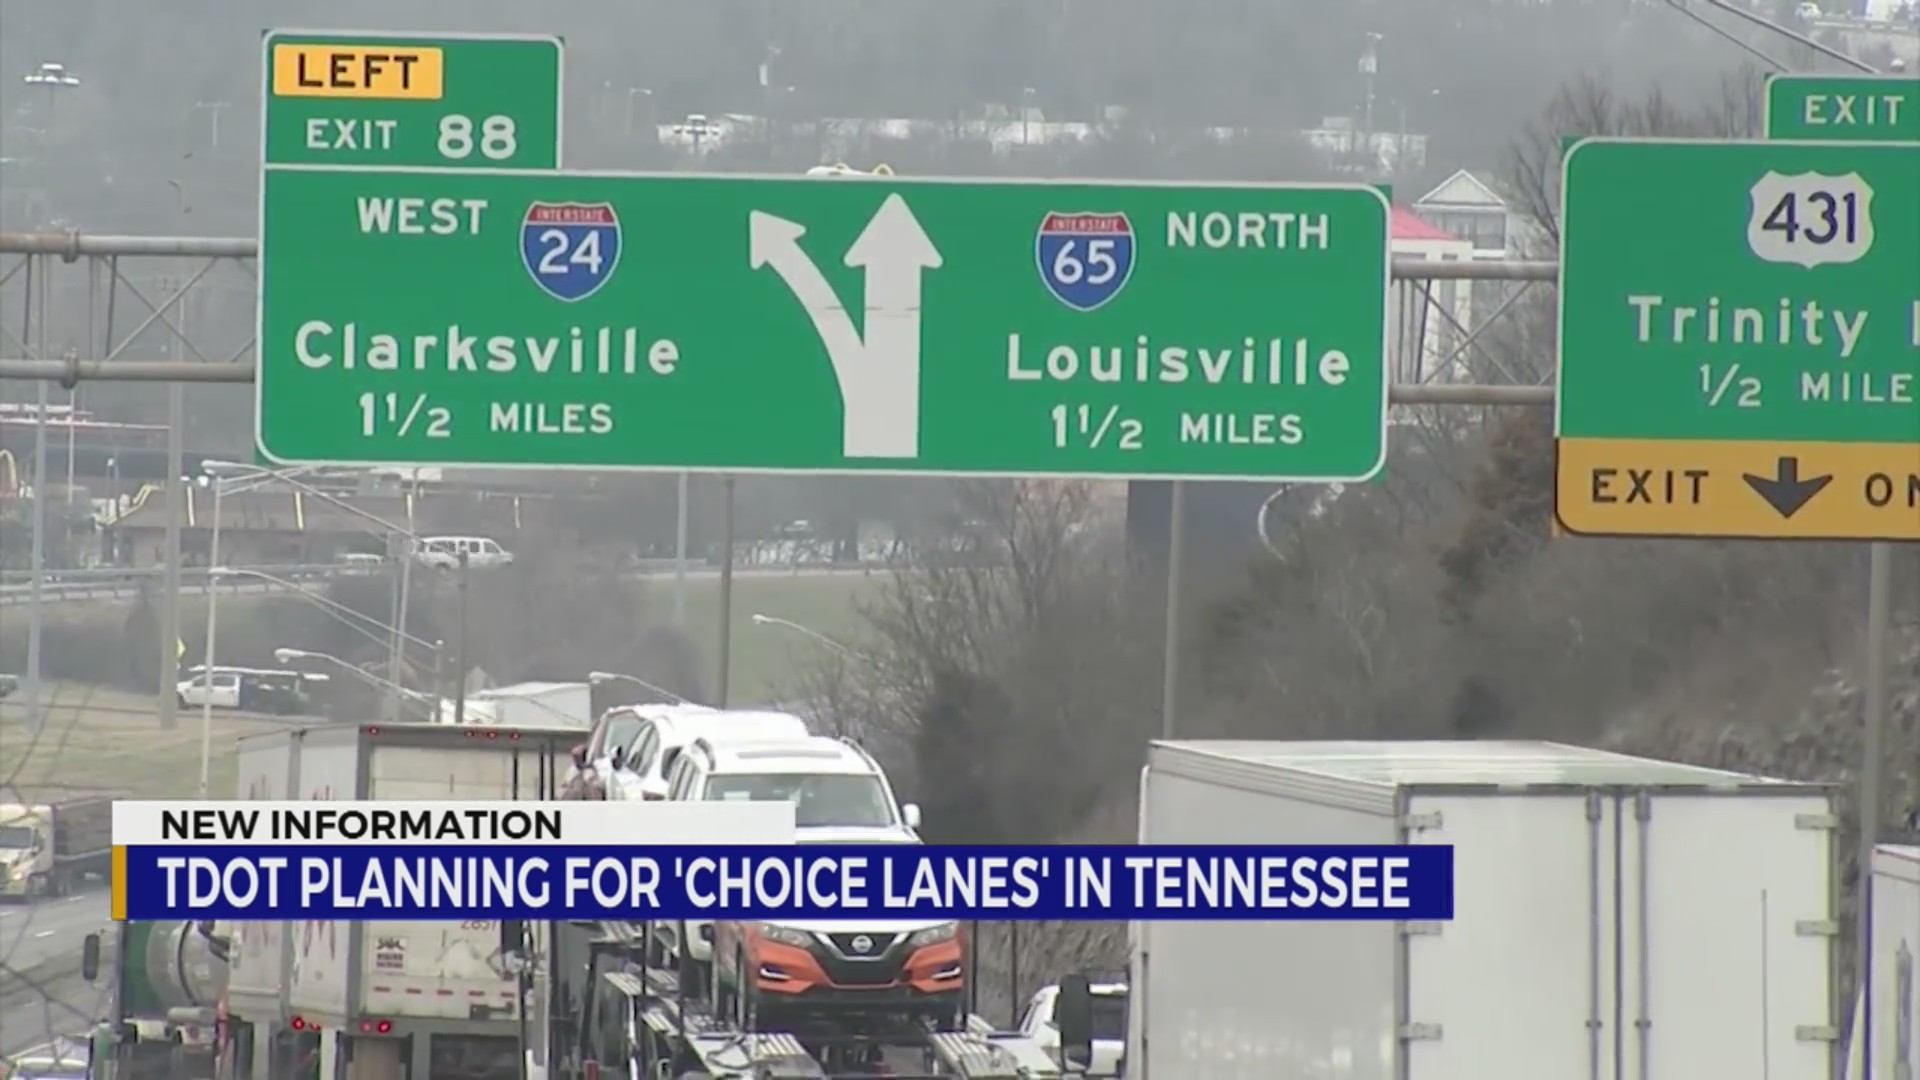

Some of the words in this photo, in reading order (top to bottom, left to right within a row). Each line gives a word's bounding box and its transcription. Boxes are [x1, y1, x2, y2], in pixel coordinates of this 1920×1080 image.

[298, 53, 419, 90] LEFT
[1805, 94, 1904, 125] EXIT
[307, 118, 397, 149] EXIT
[438, 114, 517, 160] 88
[357, 197, 488, 235] WEST
[535, 207, 606, 221] INTERSTATE
[1052, 217, 1119, 231] INTERSTATE
[1167, 211, 1328, 249] NORTH
[1762, 190, 1856, 245] 431
[539, 229, 603, 274] 24
[1054, 239, 1116, 284] 65
[1628, 295, 1868, 358] Trinity
[295, 320, 679, 375] Clarksville
[1008, 333, 1350, 385] Louisville
[1801, 371, 1913, 403] MILE
[490, 402, 613, 434] MILES
[1181, 413, 1303, 445] MILES
[1592, 468, 1709, 504] EXIT
